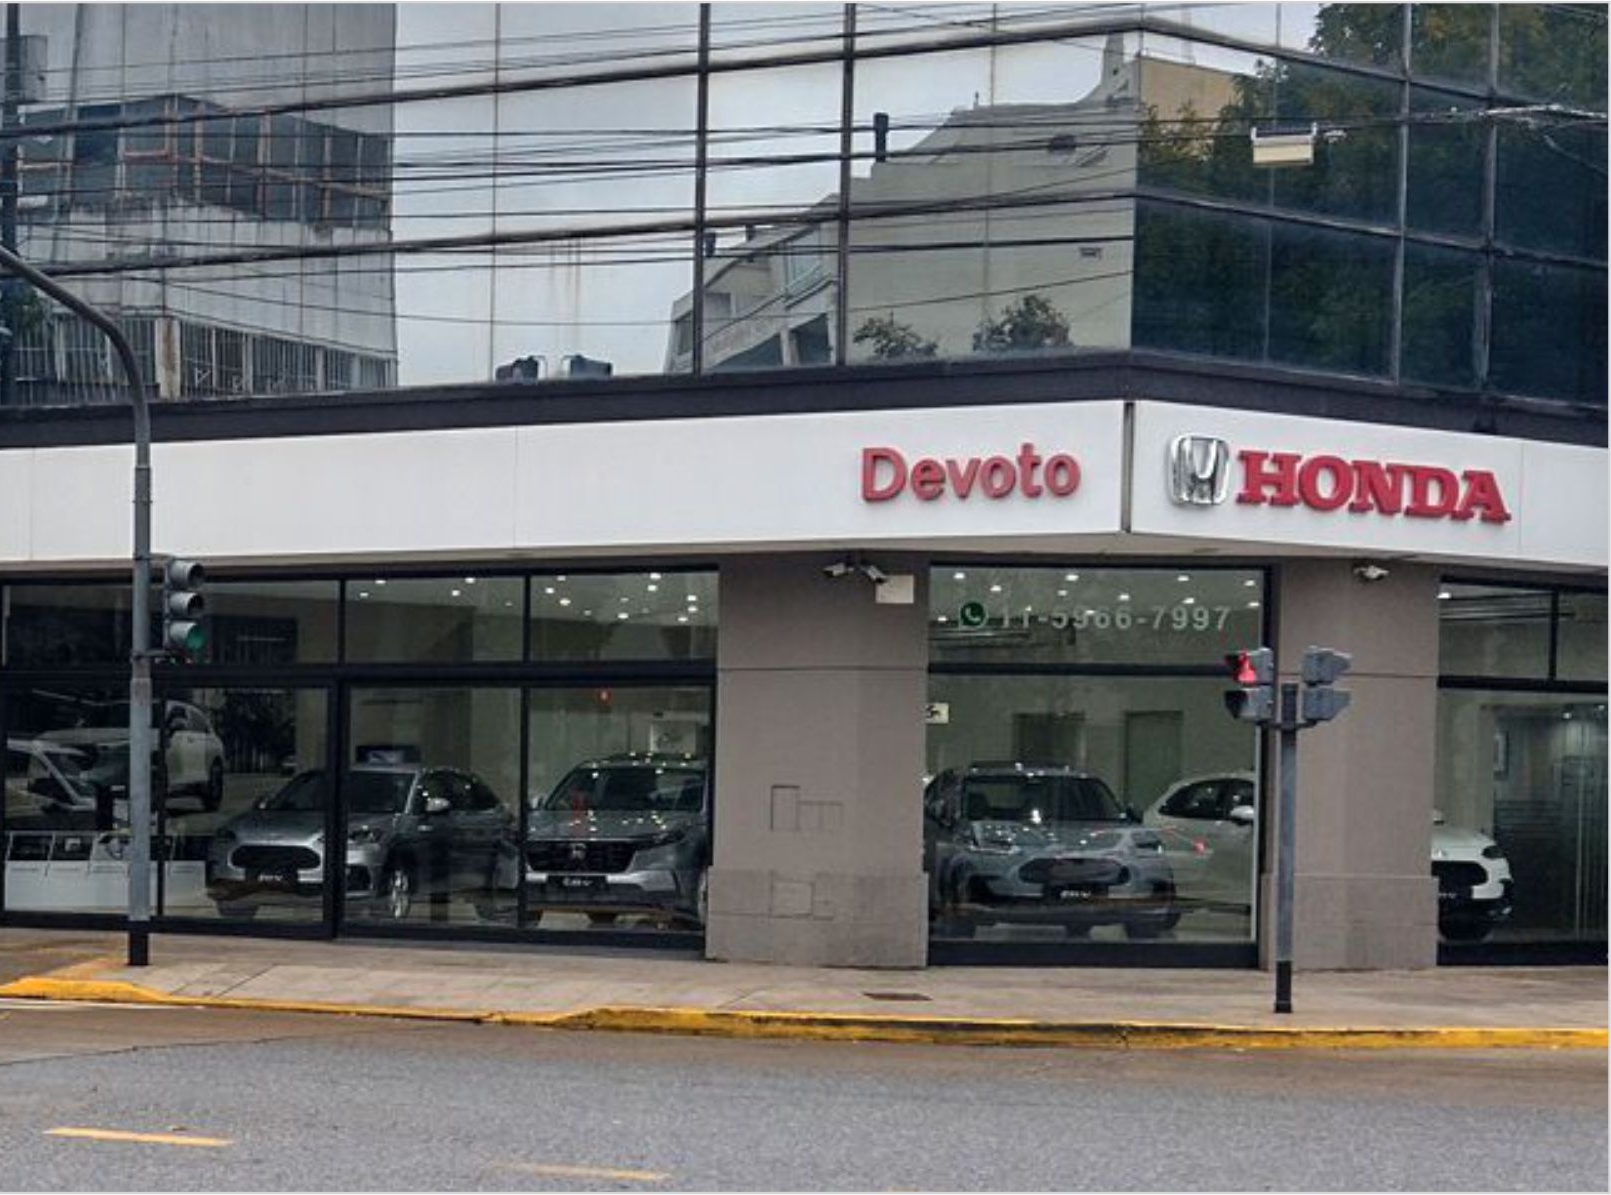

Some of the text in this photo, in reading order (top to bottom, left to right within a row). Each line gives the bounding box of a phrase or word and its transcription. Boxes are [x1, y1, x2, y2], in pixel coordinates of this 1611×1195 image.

[862, 442, 1081, 502] Devoto
[1236, 450, 1512, 525] HONDA
[999, 606, 1231, 631] 11-5966-7997
